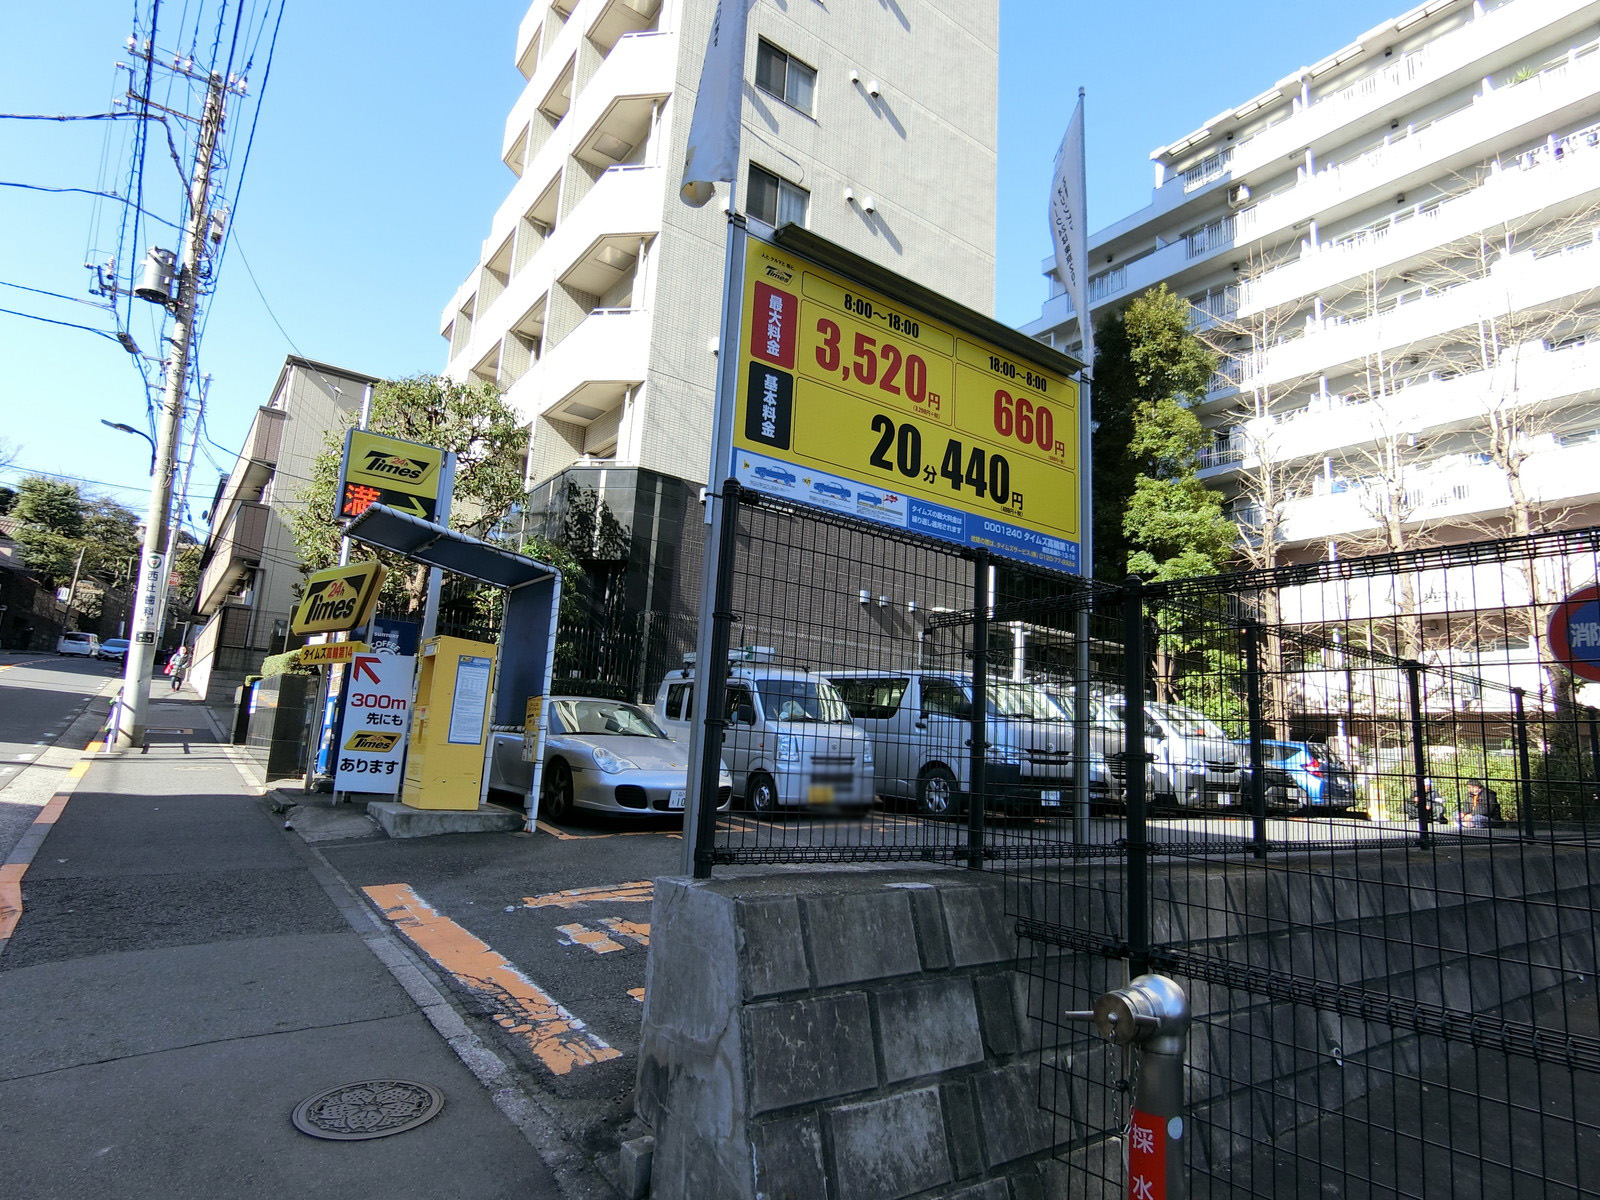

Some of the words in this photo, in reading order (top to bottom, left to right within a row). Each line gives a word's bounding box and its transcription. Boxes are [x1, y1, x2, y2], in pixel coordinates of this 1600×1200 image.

[767, 294, 782, 357] 最大料金
[816, 318, 940, 411] 3,520円
[761, 374, 778, 438] 基本料金
[994, 389, 1064, 457] 660円
[364, 452, 422, 479] Times
[343, 484, 381, 516] 満
[984, 521, 1023, 539] 0001240
[304, 590, 357, 625] Times
[351, 693, 406, 710] 300m
[366, 712, 403, 726] 先にも
[354, 735, 391, 749] Times
[340, 757, 399, 775] あります
